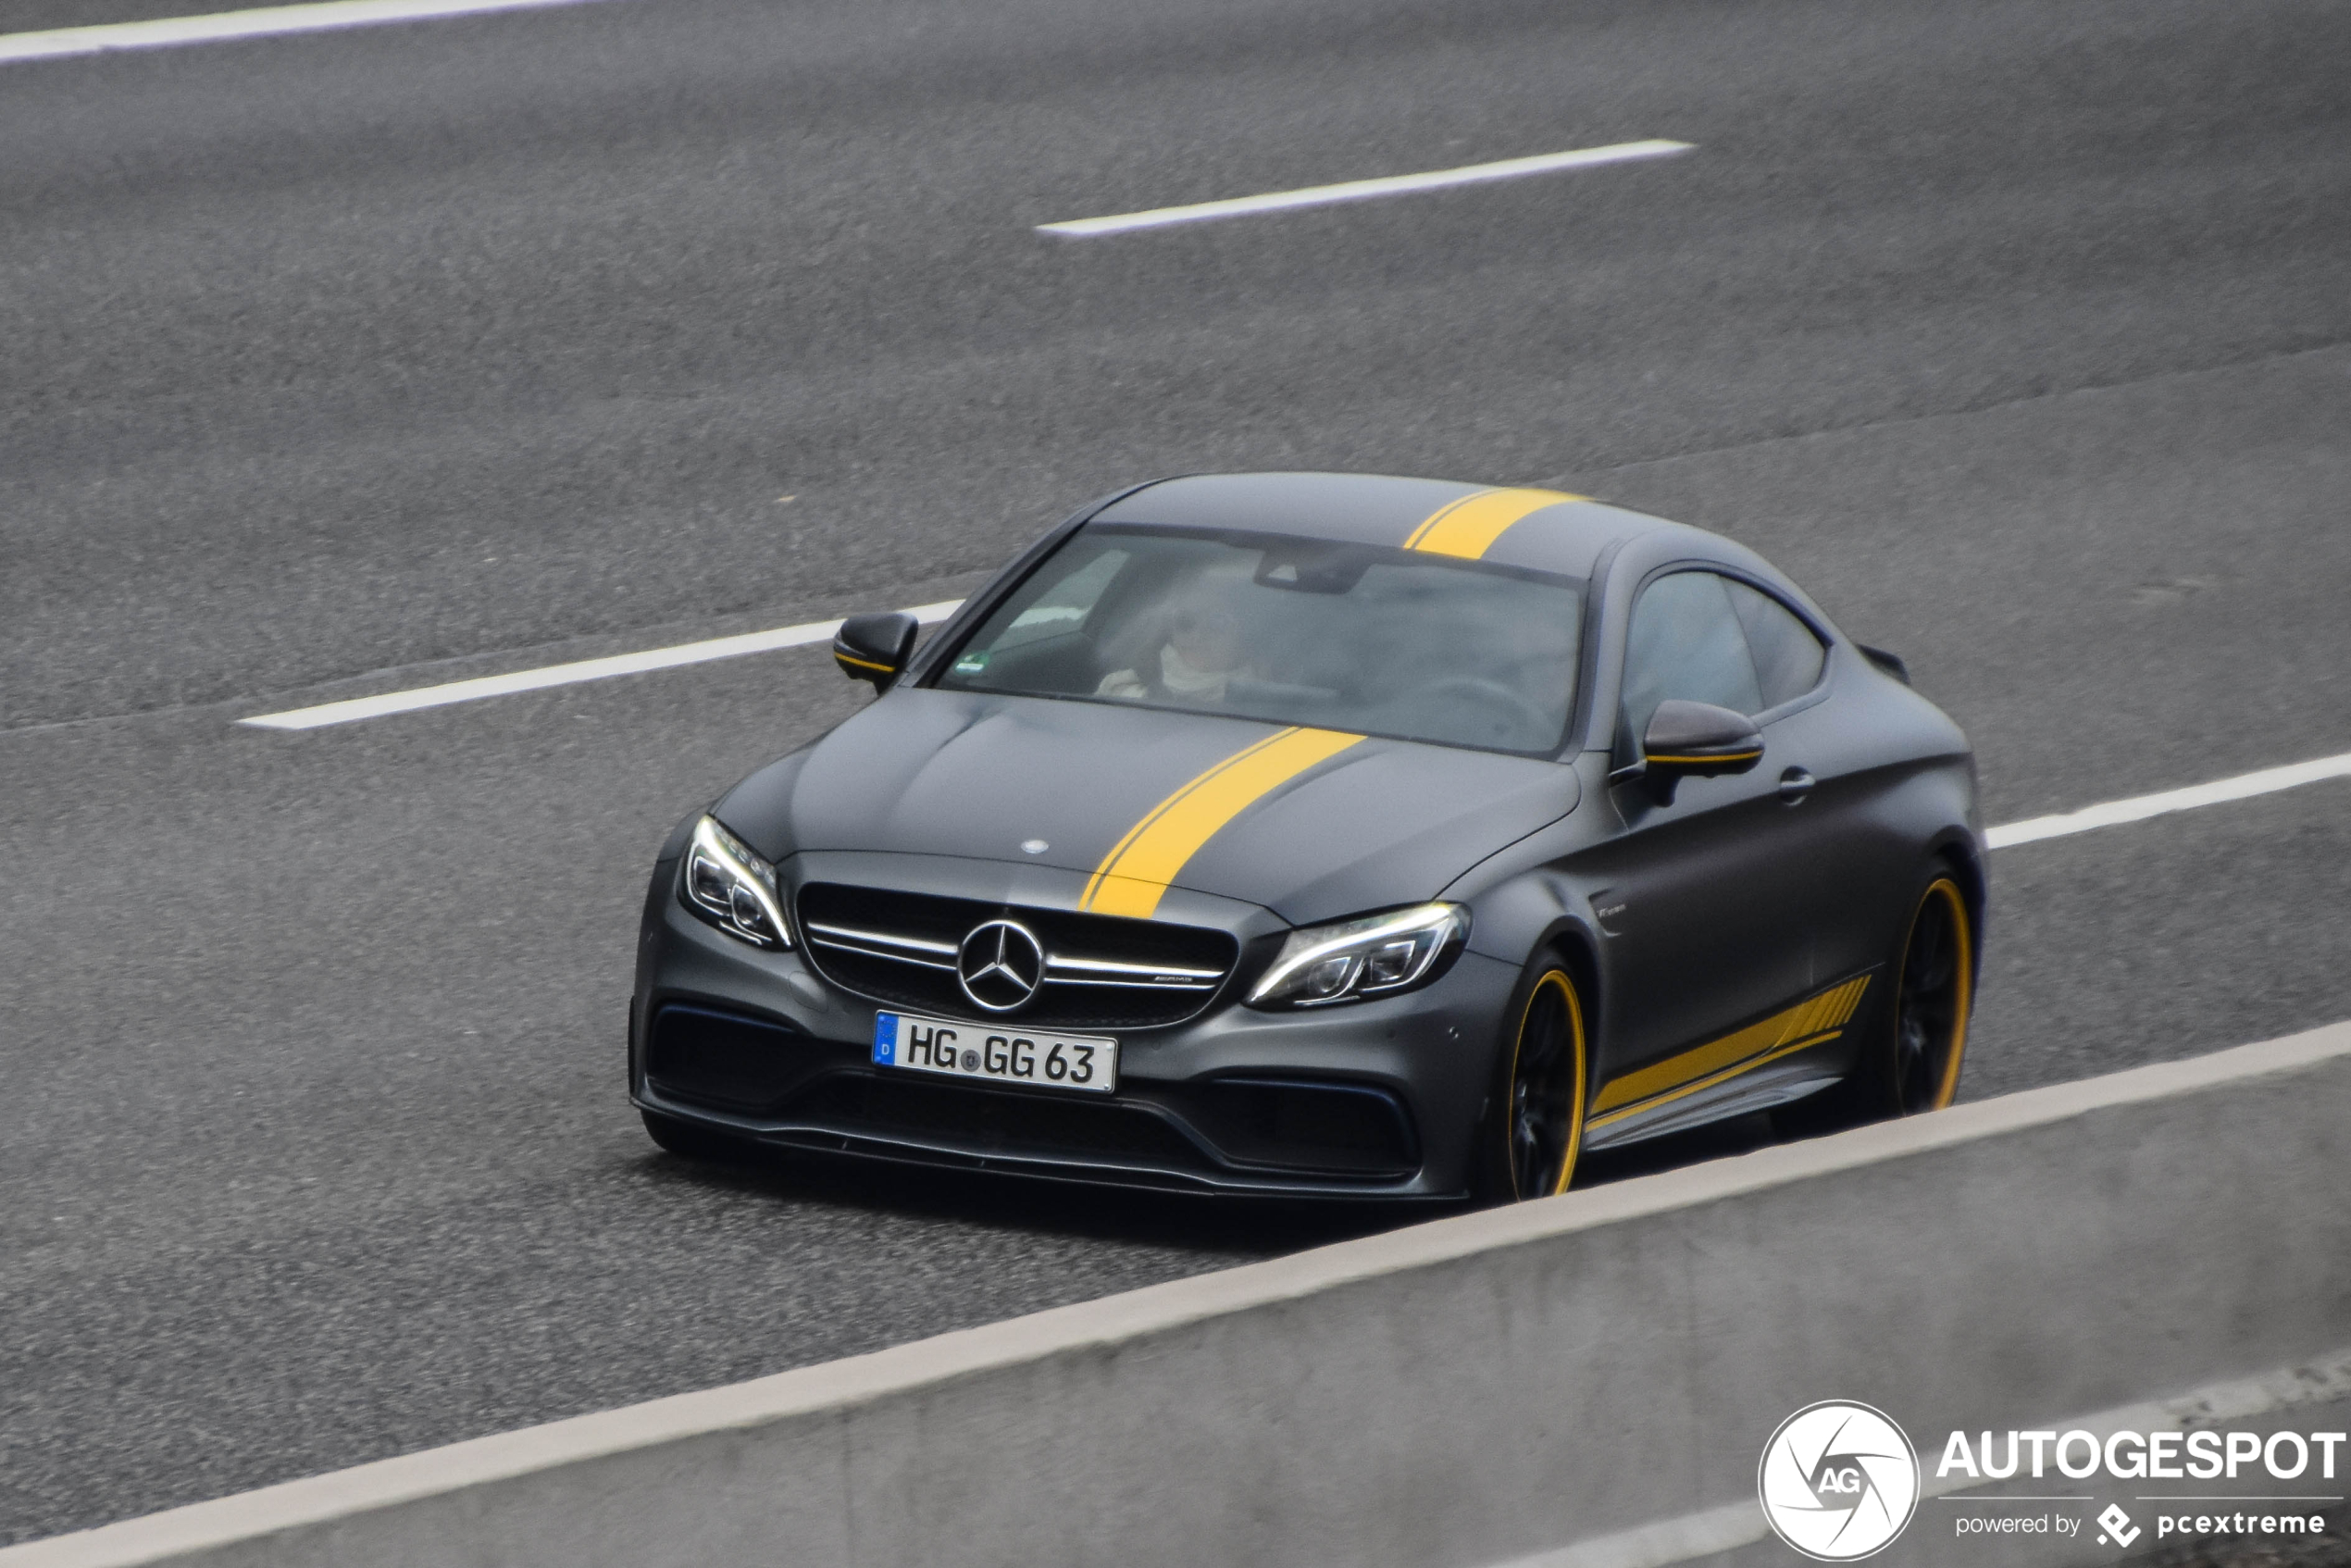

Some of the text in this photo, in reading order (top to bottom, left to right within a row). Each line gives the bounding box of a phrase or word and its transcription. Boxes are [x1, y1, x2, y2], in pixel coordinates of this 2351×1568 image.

[881, 1043, 890, 1055] D
[907, 1025, 1095, 1083] HG GG 63
